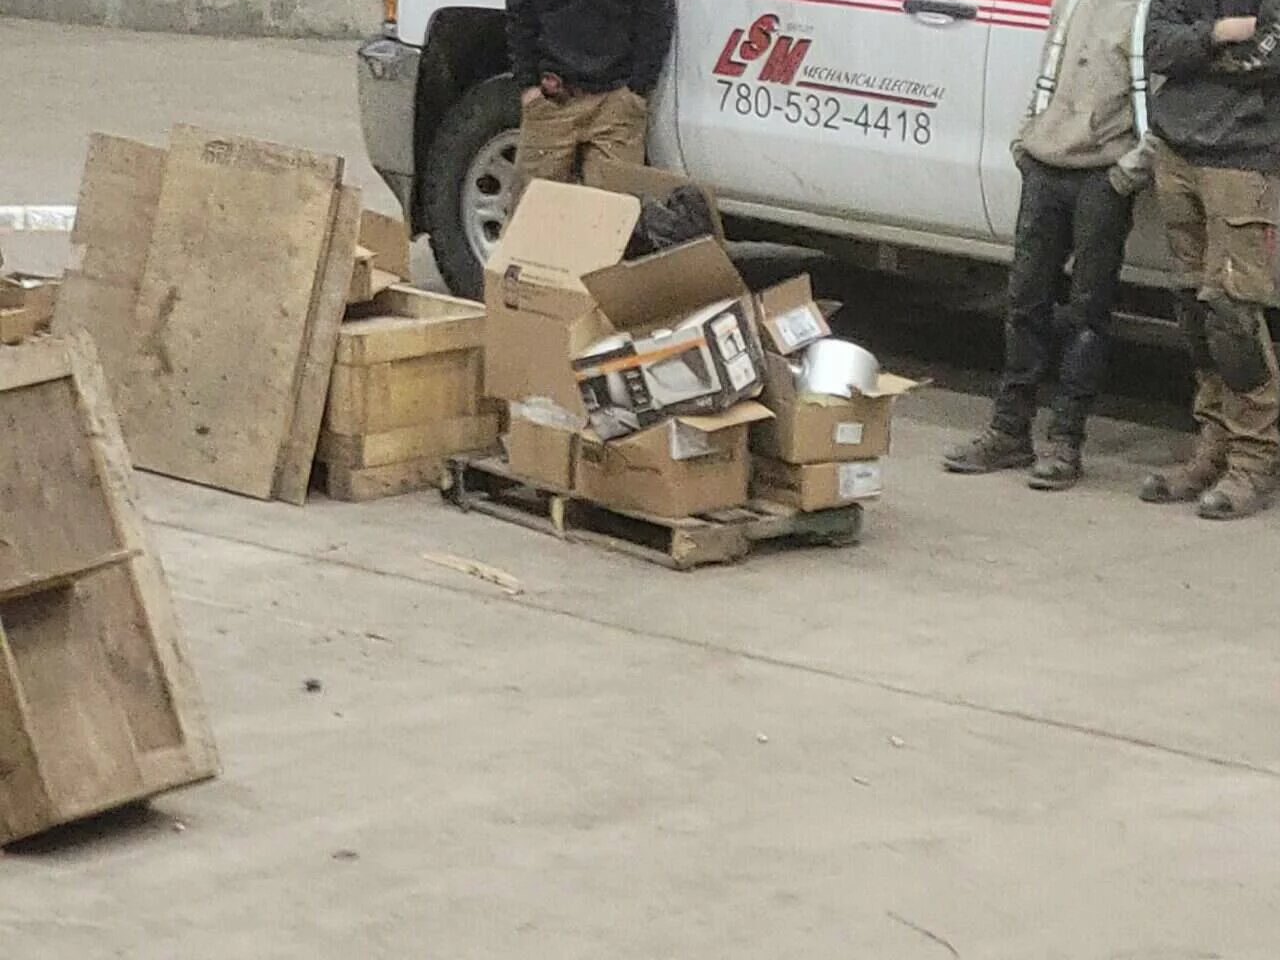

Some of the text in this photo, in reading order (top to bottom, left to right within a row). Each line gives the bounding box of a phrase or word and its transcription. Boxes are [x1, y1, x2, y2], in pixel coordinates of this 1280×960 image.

[712, 13, 812, 85] LSM
[803, 64, 946, 100] MECHANICAL ELECTRICAL
[716, 78, 932, 146] 780-532-4418
